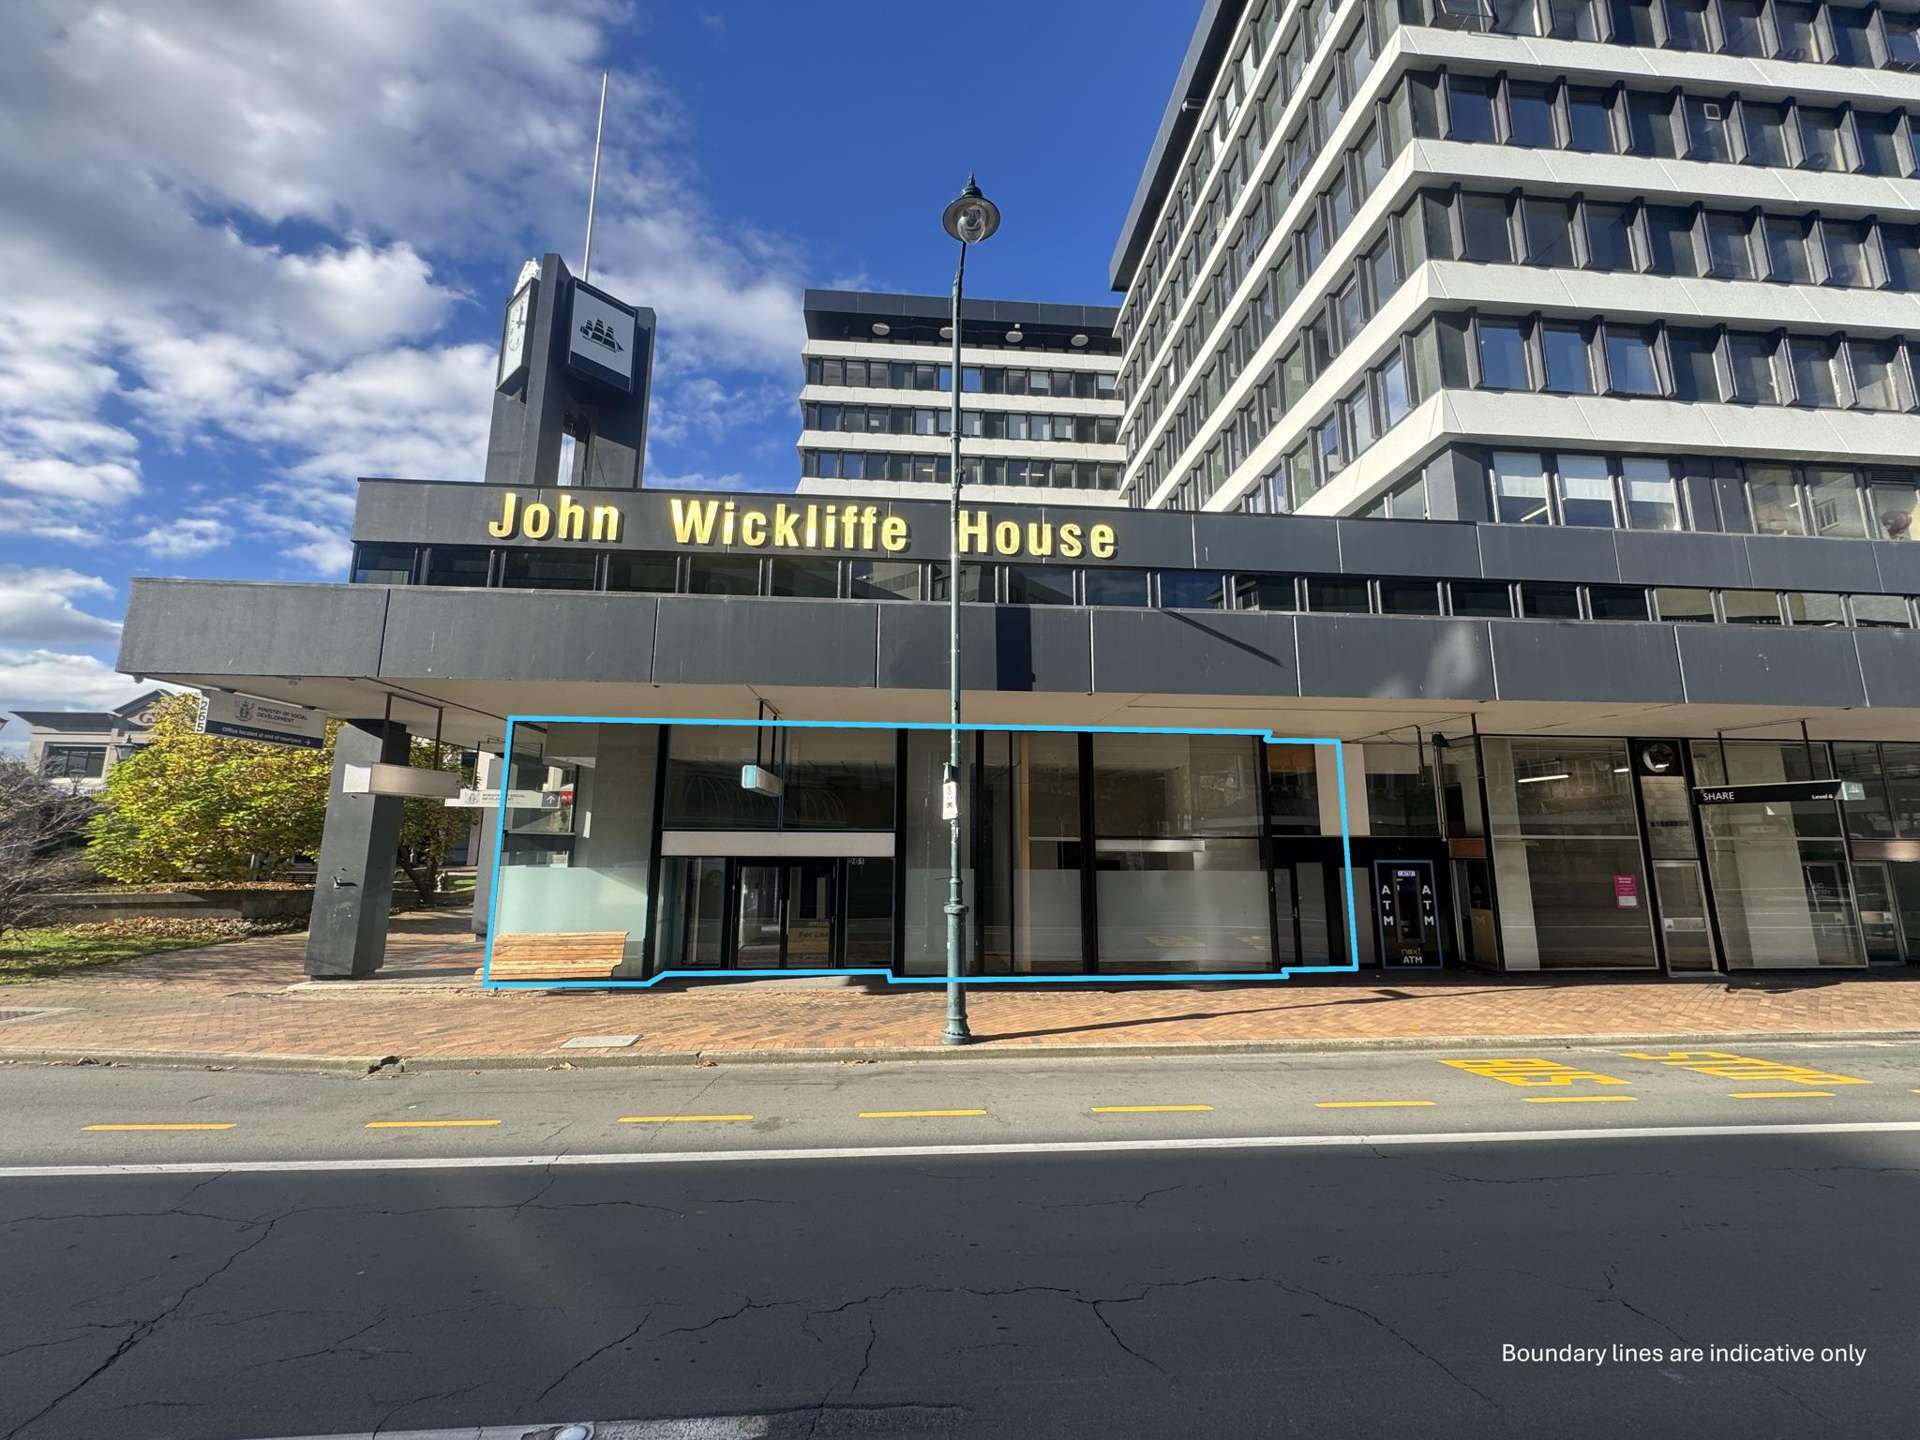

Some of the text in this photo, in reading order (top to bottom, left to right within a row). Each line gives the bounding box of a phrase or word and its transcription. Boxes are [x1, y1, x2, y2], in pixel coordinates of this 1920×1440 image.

[488, 492, 1115, 559] John Wickliffe House
[196, 700, 208, 732] 265
[256, 712, 296, 724] DEVELOPMENT
[1702, 791, 1735, 801] SHARE
[1381, 884, 1395, 927] ATM
[1421, 884, 1435, 927] ATM
[1402, 955, 1423, 965] ATM
[1439, 1057, 1632, 1087] BUS
[1618, 1050, 1873, 1086] STOP
